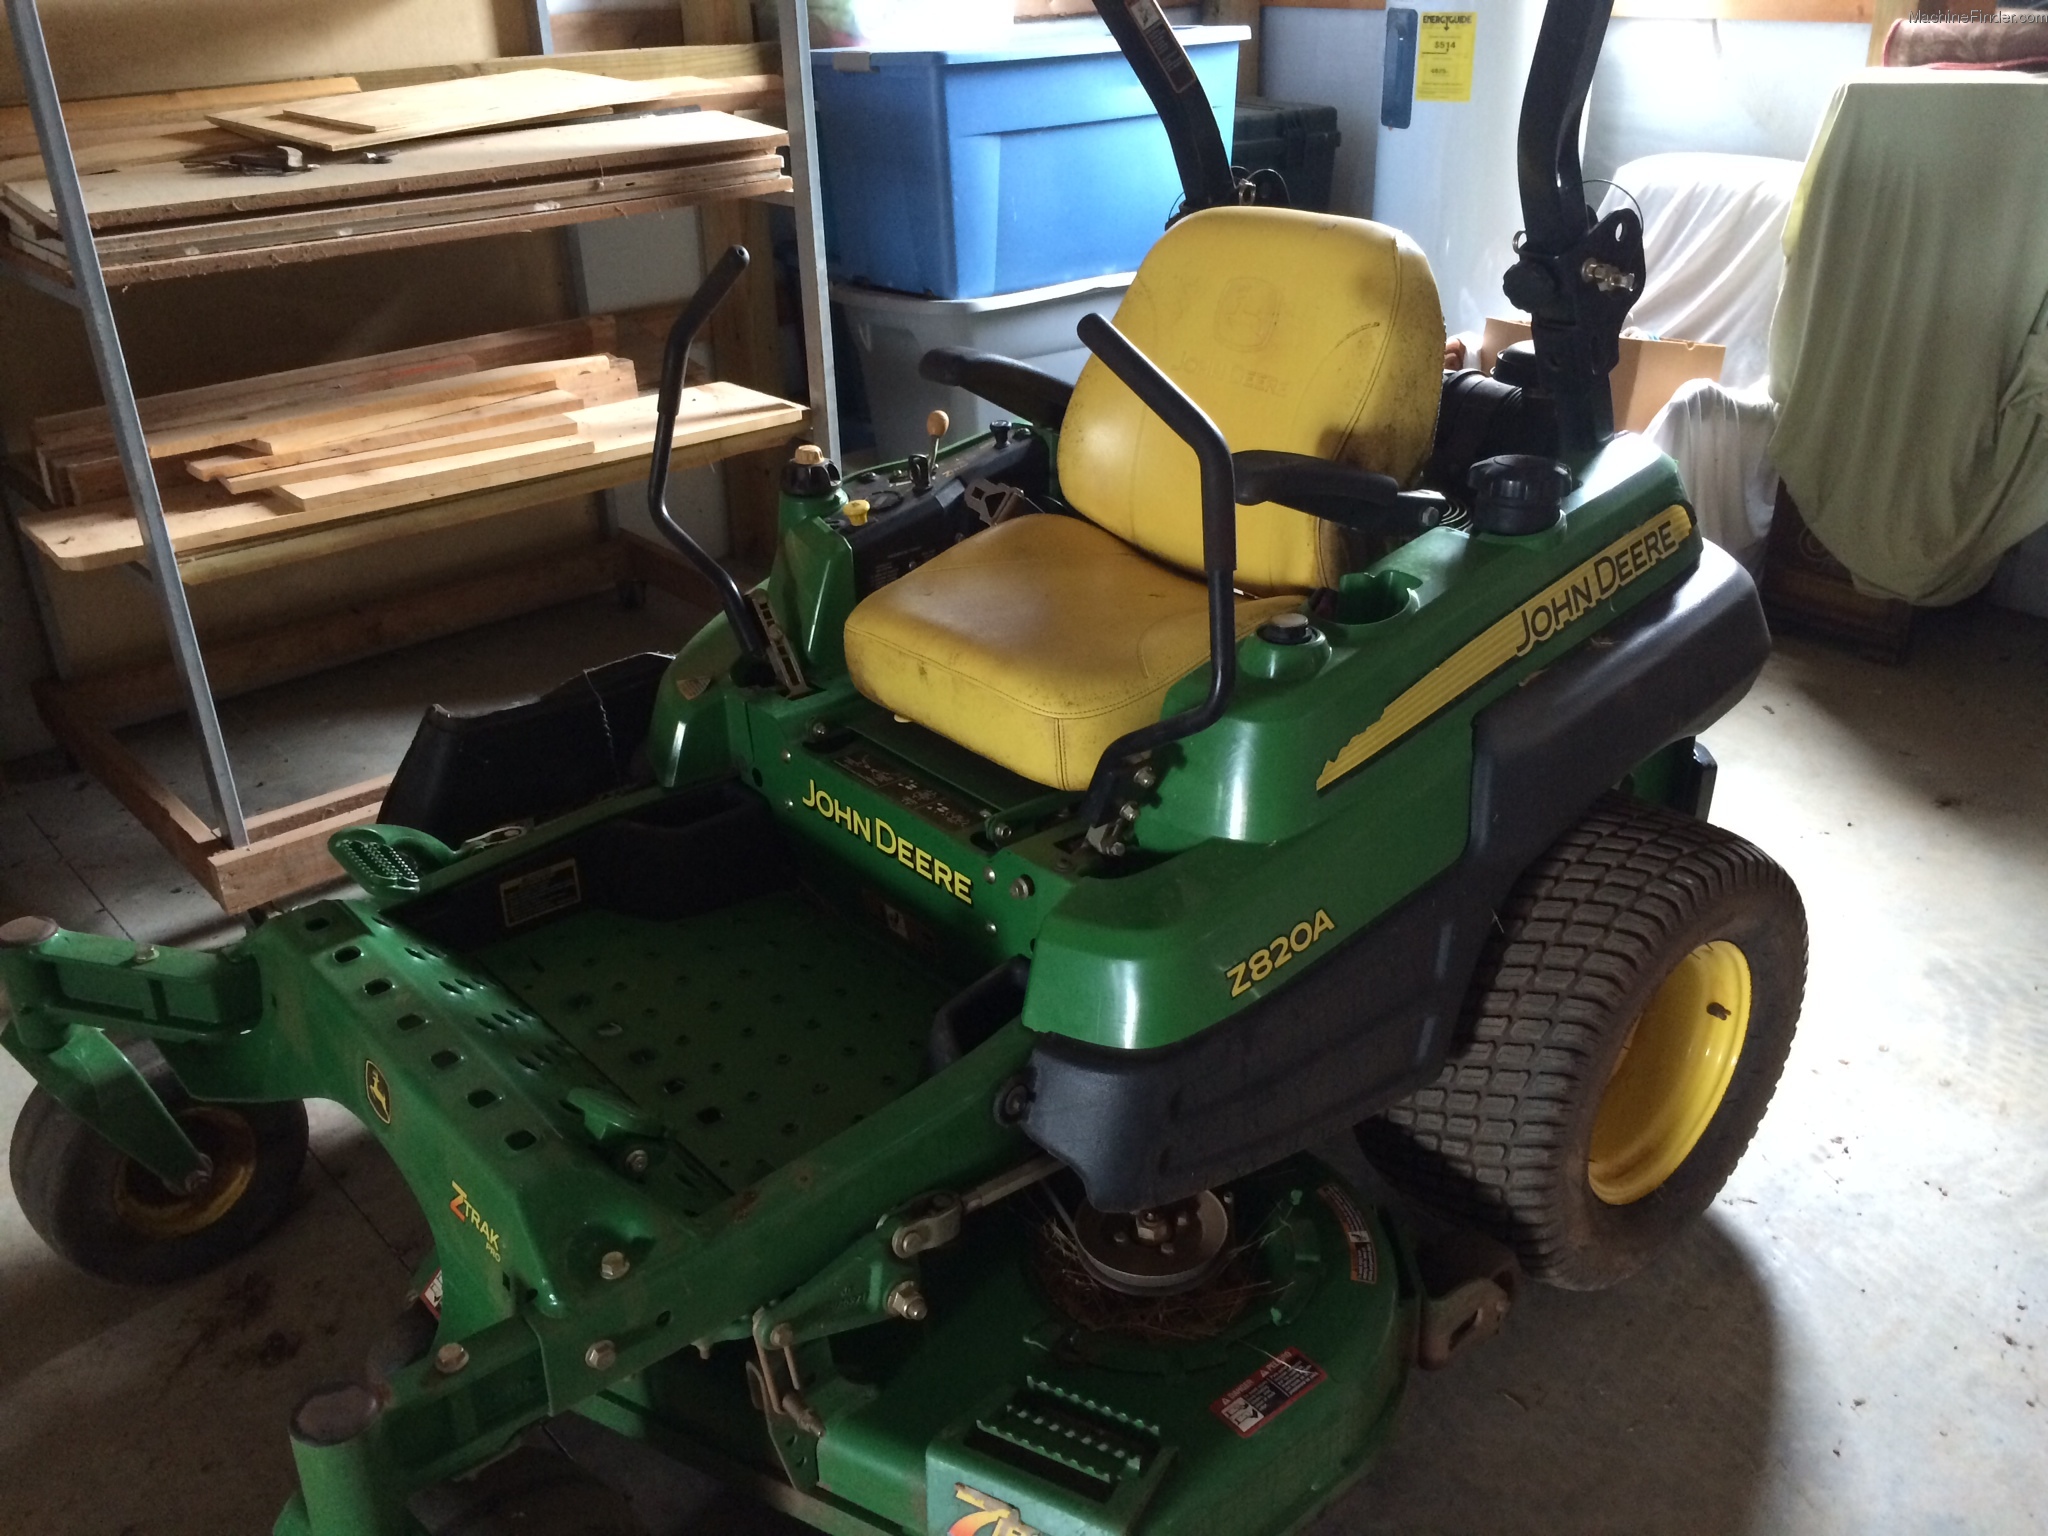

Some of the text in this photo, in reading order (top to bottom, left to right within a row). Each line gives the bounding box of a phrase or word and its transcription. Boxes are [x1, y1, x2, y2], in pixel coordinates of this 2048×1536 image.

[1422, 15, 1472, 25] ENERGYGUIDE
[1516, 520, 1677, 653] JOHN DEERE
[802, 778, 871, 843] JOHN
[875, 817, 972, 905] DEERE
[1226, 908, 1335, 998] Z820A
[485, 1242, 501, 1262] PRO
